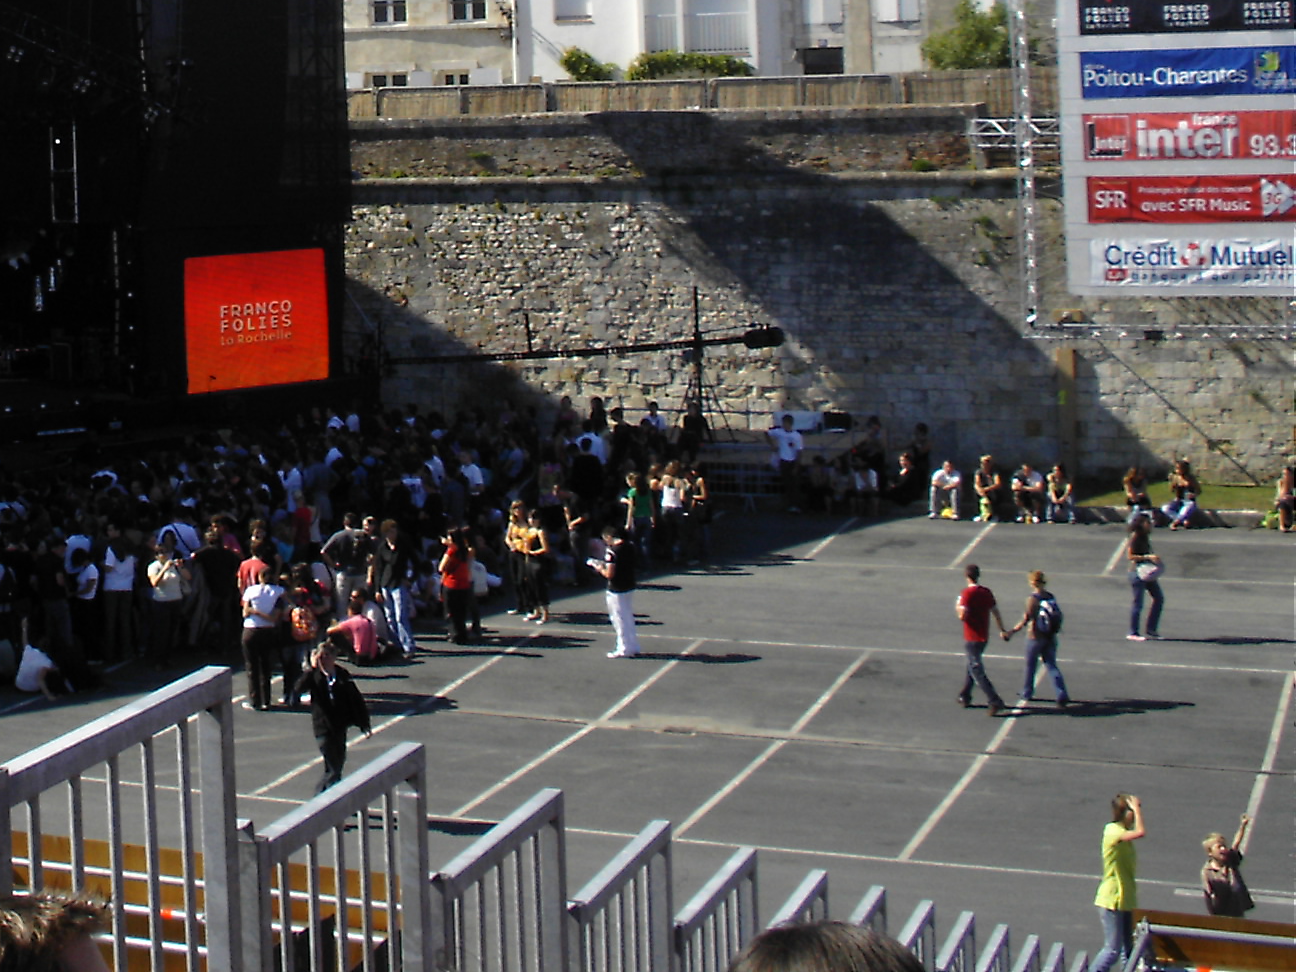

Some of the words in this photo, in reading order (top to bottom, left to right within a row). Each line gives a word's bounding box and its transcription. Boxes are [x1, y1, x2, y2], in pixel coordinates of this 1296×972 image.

[1085, 7, 1130, 15] FRANCO
[1163, 4, 1209, 12] FRANCO
[1243, 1, 1290, 9] FRANCO
[1085, 14, 1130, 23] FOLIES
[1164, 12, 1210, 21] FOLIES
[1244, 9, 1291, 18] FOLIES
[1083, 67, 1248, 87] Poitou-Charentes
[1192, 114, 1236, 125] france
[1095, 136, 1127, 149] inter
[1136, 120, 1240, 157] inter
[1095, 191, 1127, 208] SFR
[1141, 202, 1175, 212] avec
[1178, 198, 1206, 211] SFR
[1210, 198, 1251, 211] Music
[1105, 245, 1177, 266] Crédit
[1211, 245, 1294, 266] Mutuel
[220, 300, 292, 318] FRANCO
[221, 314, 292, 333] FOLIES
[238, 330, 292, 343] Rochelle
